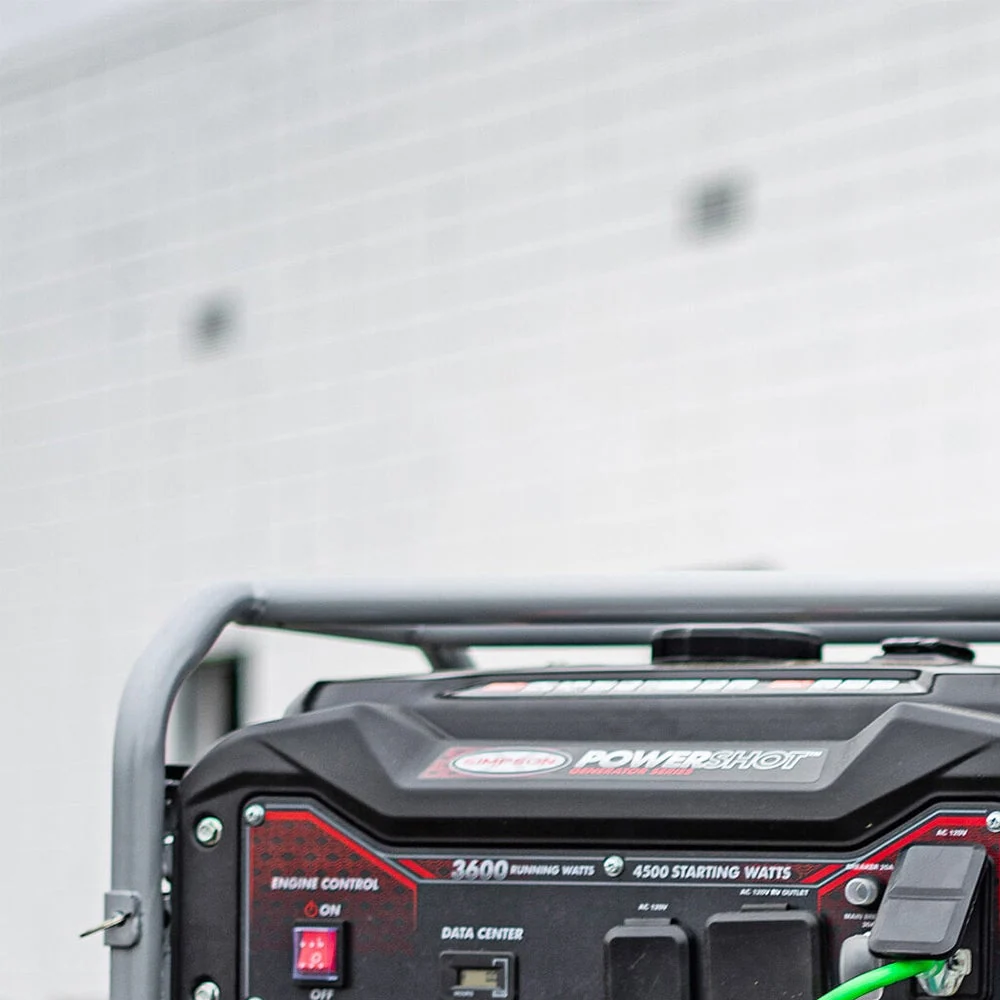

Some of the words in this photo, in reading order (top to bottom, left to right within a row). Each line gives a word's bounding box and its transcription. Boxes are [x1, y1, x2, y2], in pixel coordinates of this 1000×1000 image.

[451, 859, 509, 881] 3600
[510, 864, 560, 875] RUNNING
[562, 865, 595, 876] WATTS
[633, 864, 669, 879] 4500
[671, 865, 740, 880] STARTING
[744, 866, 792, 880] WATTS
[271, 876, 319, 890] ENGINE
[321, 877, 380, 891] CONTROL
[319, 903, 341, 917] ON
[441, 927, 474, 939] DATA
[477, 927, 524, 940] CENTER
[309, 988, 334, 1000] OFF
